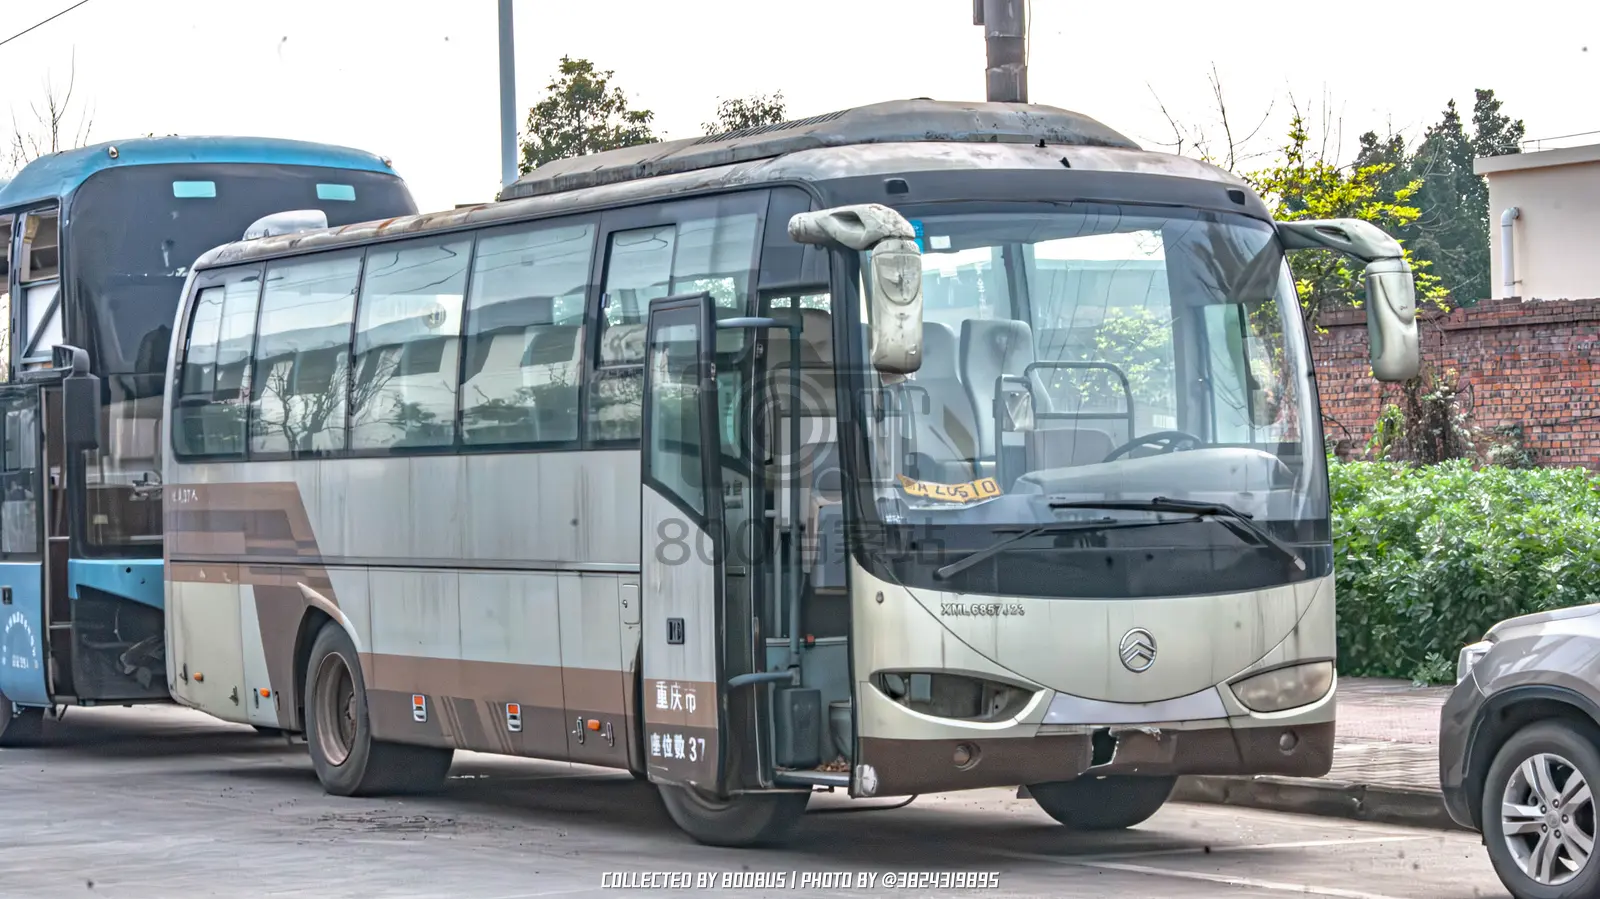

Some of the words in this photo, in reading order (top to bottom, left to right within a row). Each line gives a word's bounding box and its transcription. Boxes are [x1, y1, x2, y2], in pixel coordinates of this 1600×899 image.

[941, 603, 1025, 617] XML6857J23
[656, 681, 697, 713] 重庆市
[650, 732, 686, 759] 座位数
[688, 736, 705, 762] 37
